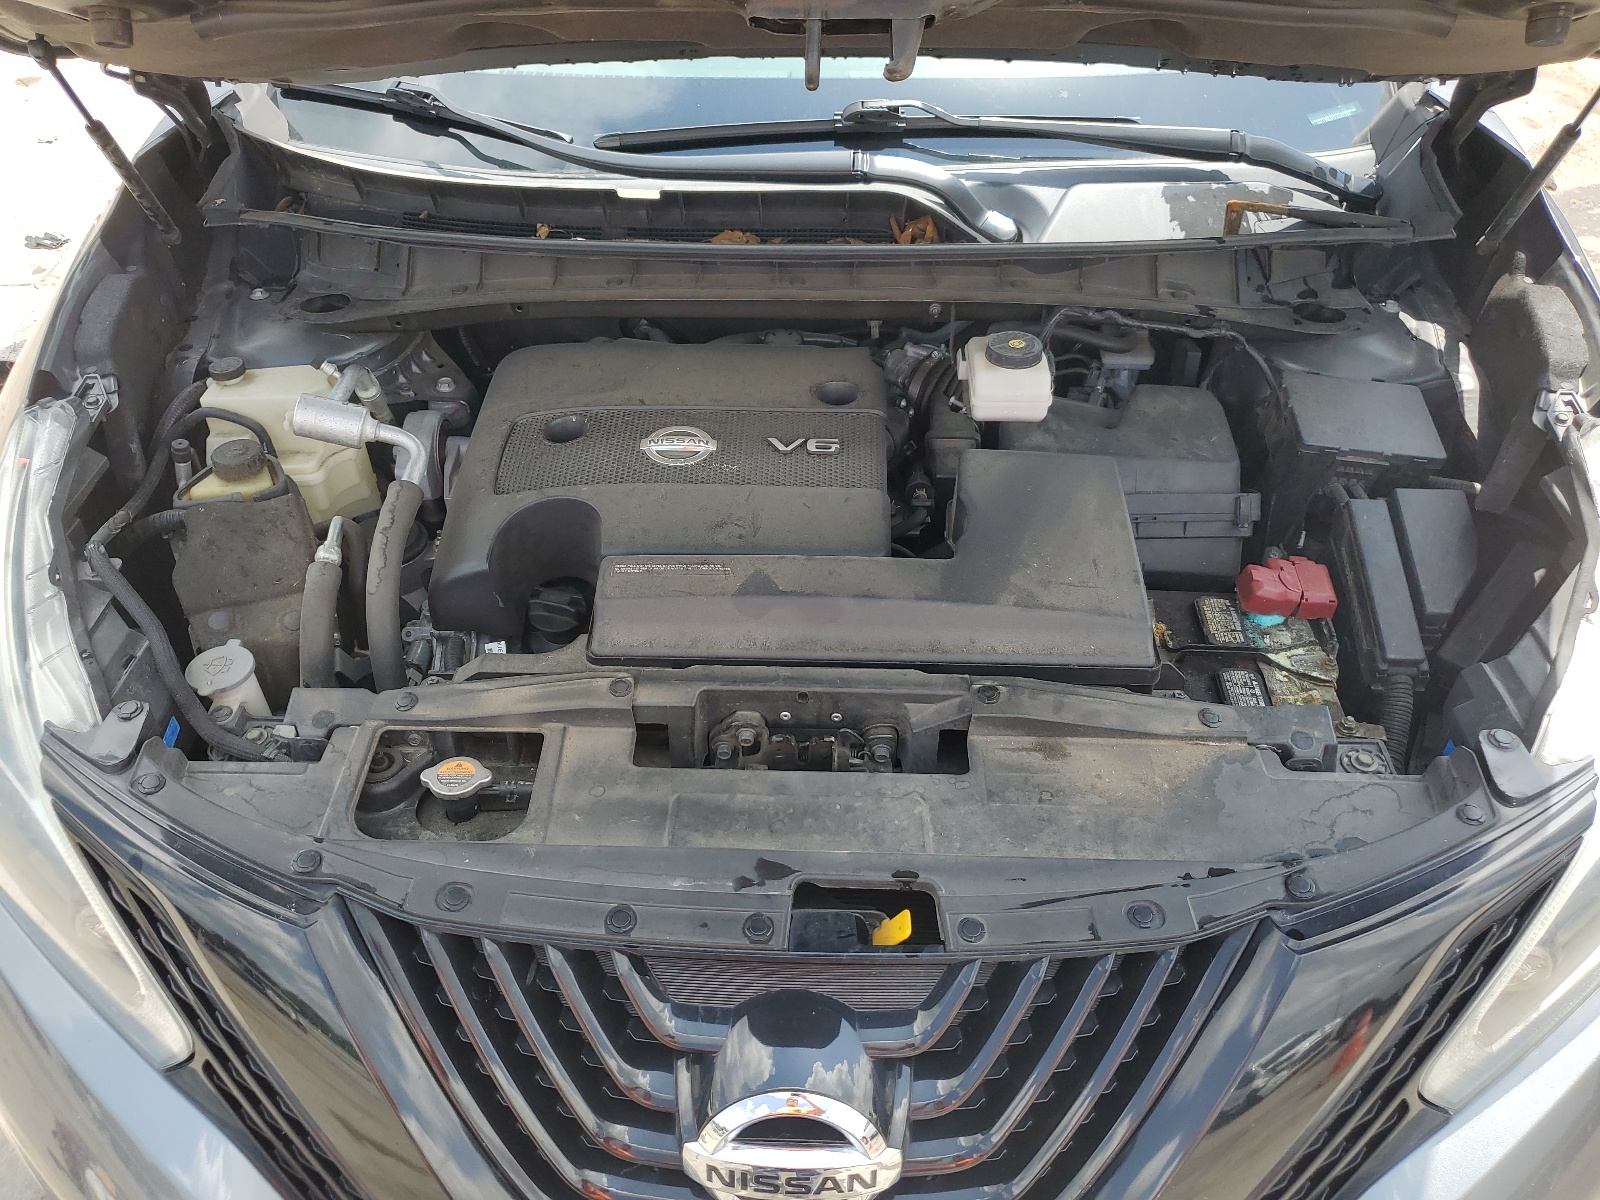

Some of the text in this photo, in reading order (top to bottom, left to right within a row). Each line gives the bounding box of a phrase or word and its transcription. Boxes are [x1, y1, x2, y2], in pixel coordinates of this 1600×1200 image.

[648, 437, 710, 446] NISSAN
[767, 437, 840, 454] V6
[706, 1163, 877, 1195] NISSAN
